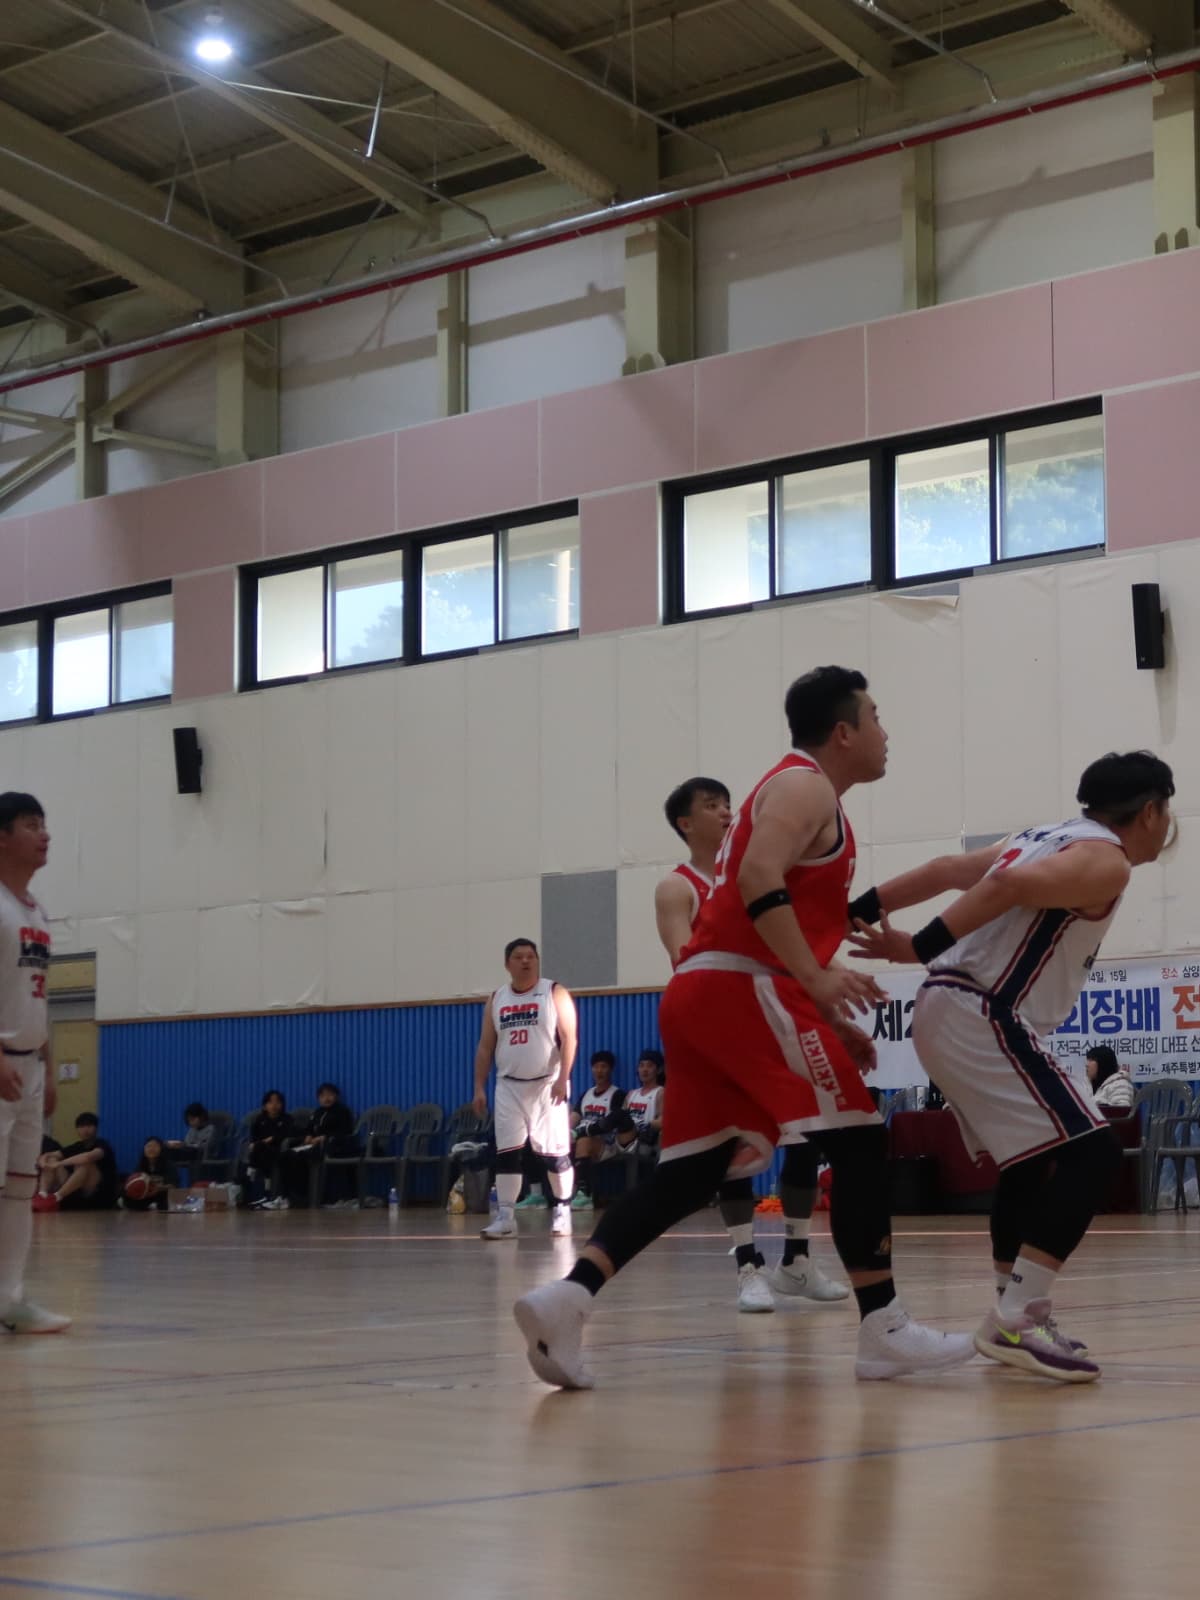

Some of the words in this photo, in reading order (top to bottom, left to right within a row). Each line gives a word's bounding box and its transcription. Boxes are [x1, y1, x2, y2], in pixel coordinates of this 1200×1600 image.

[1110, 969, 1128, 982] 15일
[1161, 967, 1178, 979] 장소
[1182, 965, 1200, 978] 삼양
[1048, 987, 1161, 1035] 회장배
[510, 1029, 529, 1045] 20
[1161, 1035, 1188, 1054] 대표
